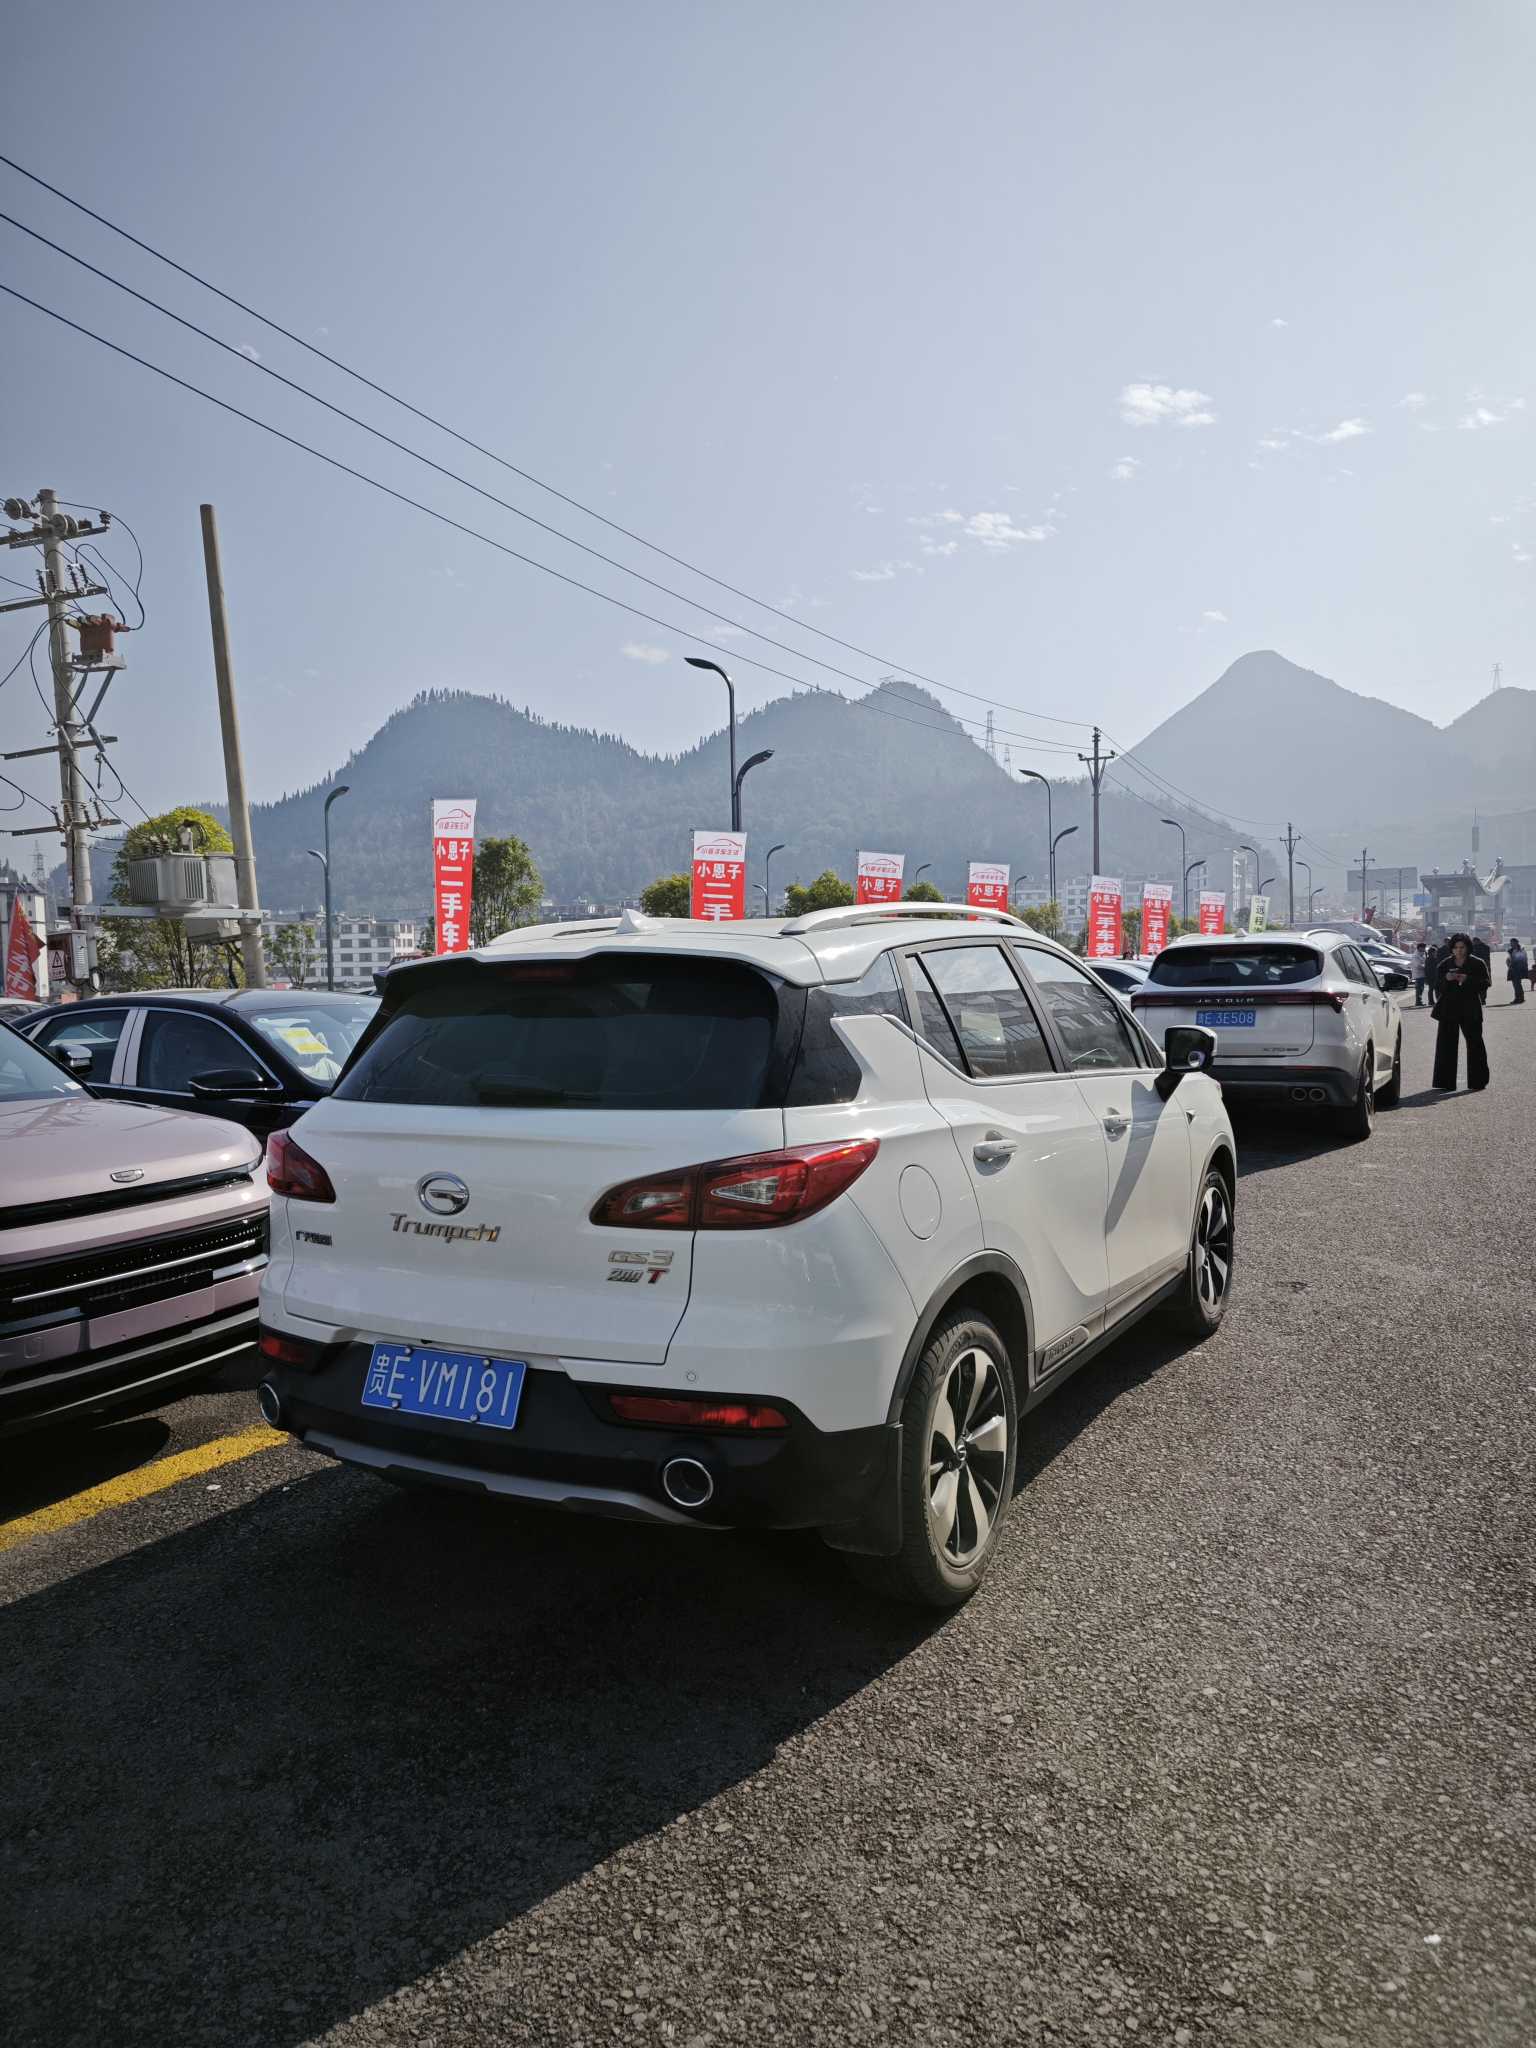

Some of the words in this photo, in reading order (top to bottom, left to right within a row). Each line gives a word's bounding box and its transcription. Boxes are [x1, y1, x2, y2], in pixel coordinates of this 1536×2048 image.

[435, 839, 470, 861] 小恩子
[696, 863, 742, 880] 小恩子
[862, 879, 898, 893] 小恩子
[972, 885, 1005, 897] 小恩子
[440, 865, 464, 953] 二手车
[389, 1212, 502, 1244] Trumpchi
[607, 1249, 674, 1266] GS3
